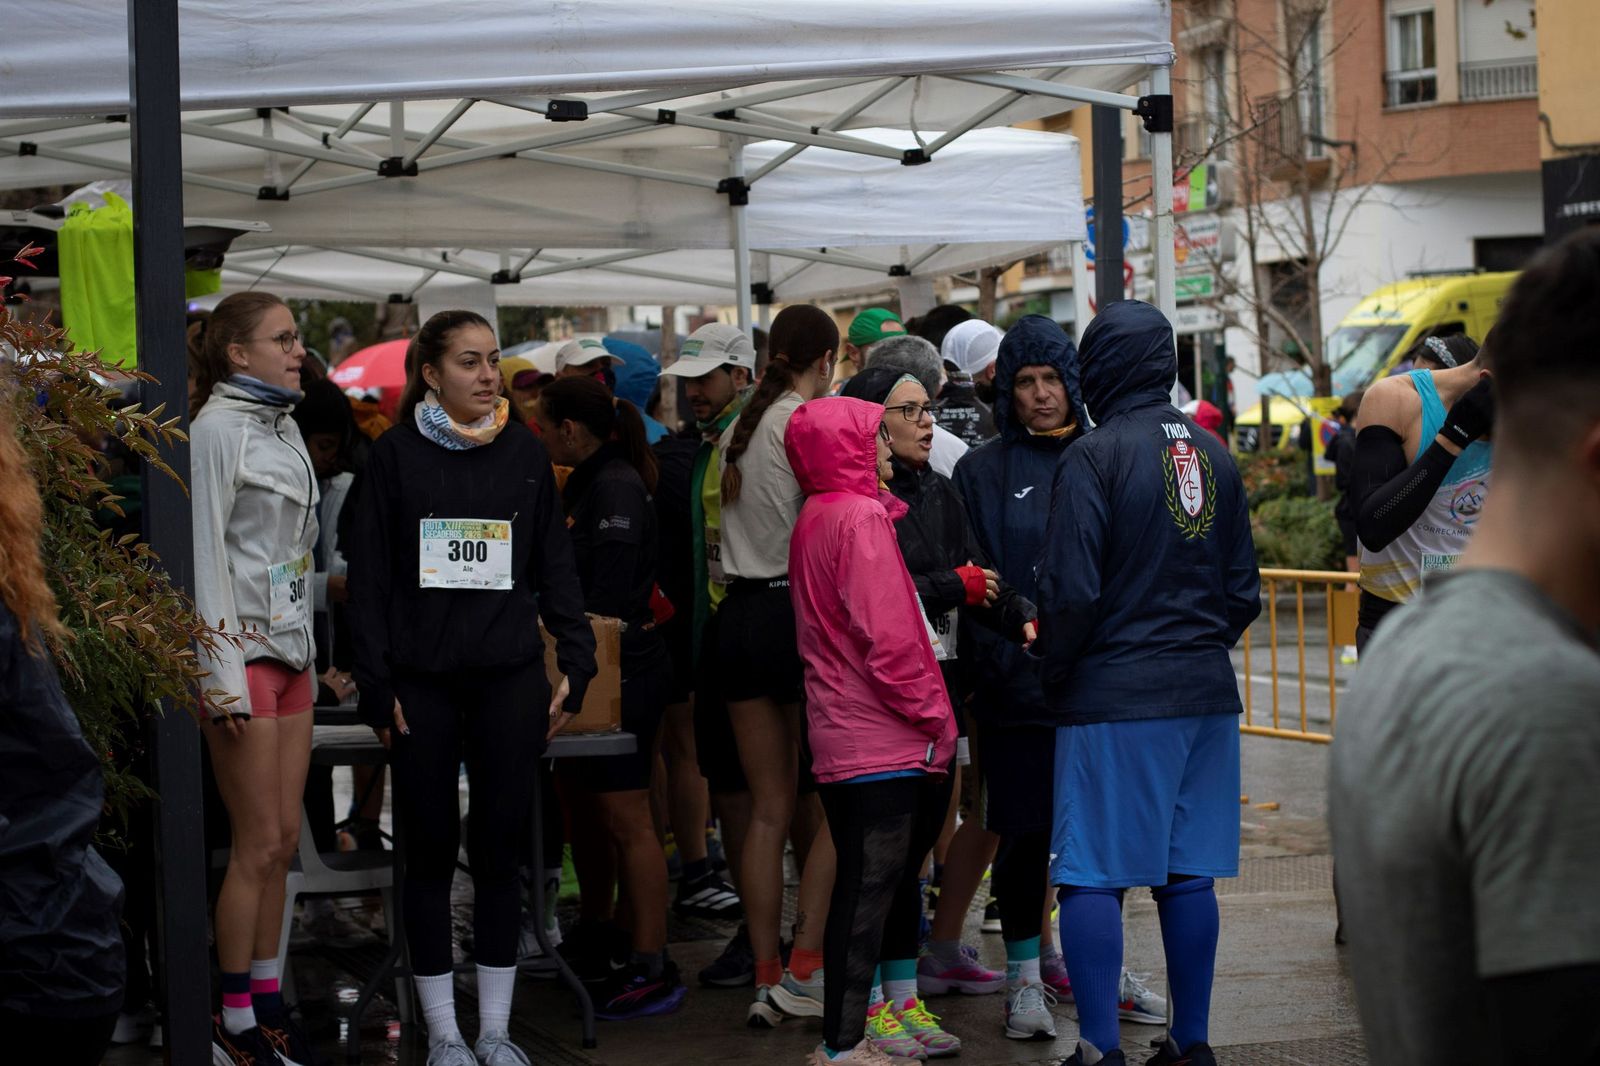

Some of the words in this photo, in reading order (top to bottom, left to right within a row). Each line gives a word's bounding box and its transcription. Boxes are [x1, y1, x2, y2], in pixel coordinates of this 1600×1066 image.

[1161, 423, 1192, 439] YNDA
[424, 521, 443, 530] RUTA
[424, 530, 463, 539] SECADEROS
[447, 540, 488, 562] 300
